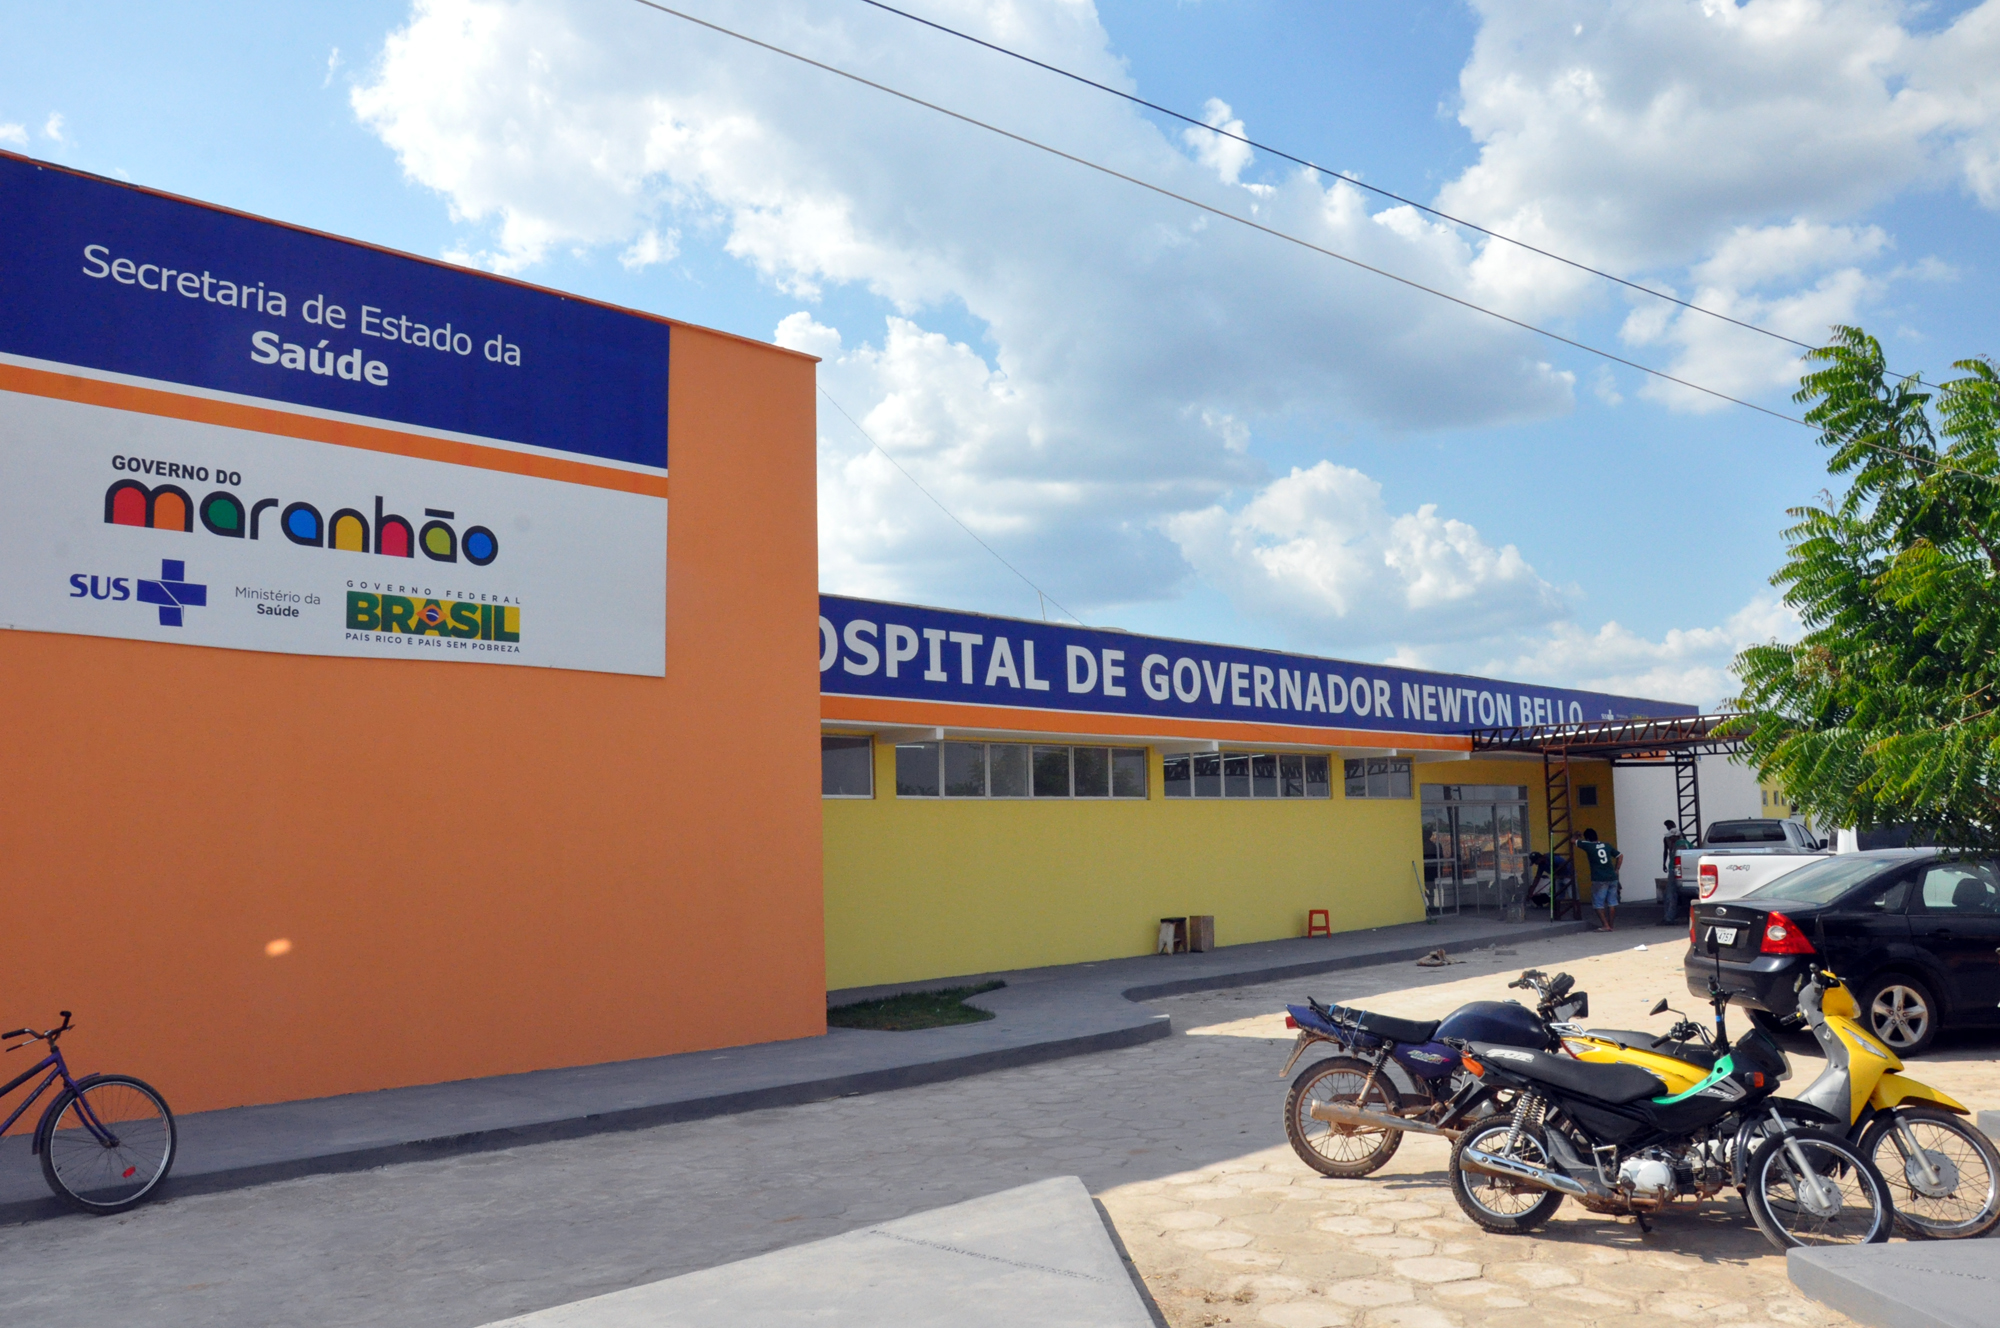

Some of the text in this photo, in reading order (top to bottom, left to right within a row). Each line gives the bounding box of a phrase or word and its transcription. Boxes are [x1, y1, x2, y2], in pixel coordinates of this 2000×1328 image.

[82, 243, 521, 367] Secretaria de Estado da
[250, 330, 389, 386] Saúde
[111, 454, 241, 486] GOVERNO DO
[69, 573, 130, 601] SUS
[235, 586, 321, 605] Ministério da
[346, 580, 520, 605] GOVERNO FEDERAL
[256, 603, 299, 618] Saúde
[346, 590, 520, 643] BRASIL
[345, 632, 520, 653] PAÍS RICO É PAÍS SEM POBREZA
[1066, 644, 1126, 697] DE
[1141, 653, 1395, 718] GOVERNADOR
[1401, 681, 1513, 727] NEWTON
[1518, 695, 1583, 731] BELLO
[1597, 848, 1608, 864] 9
